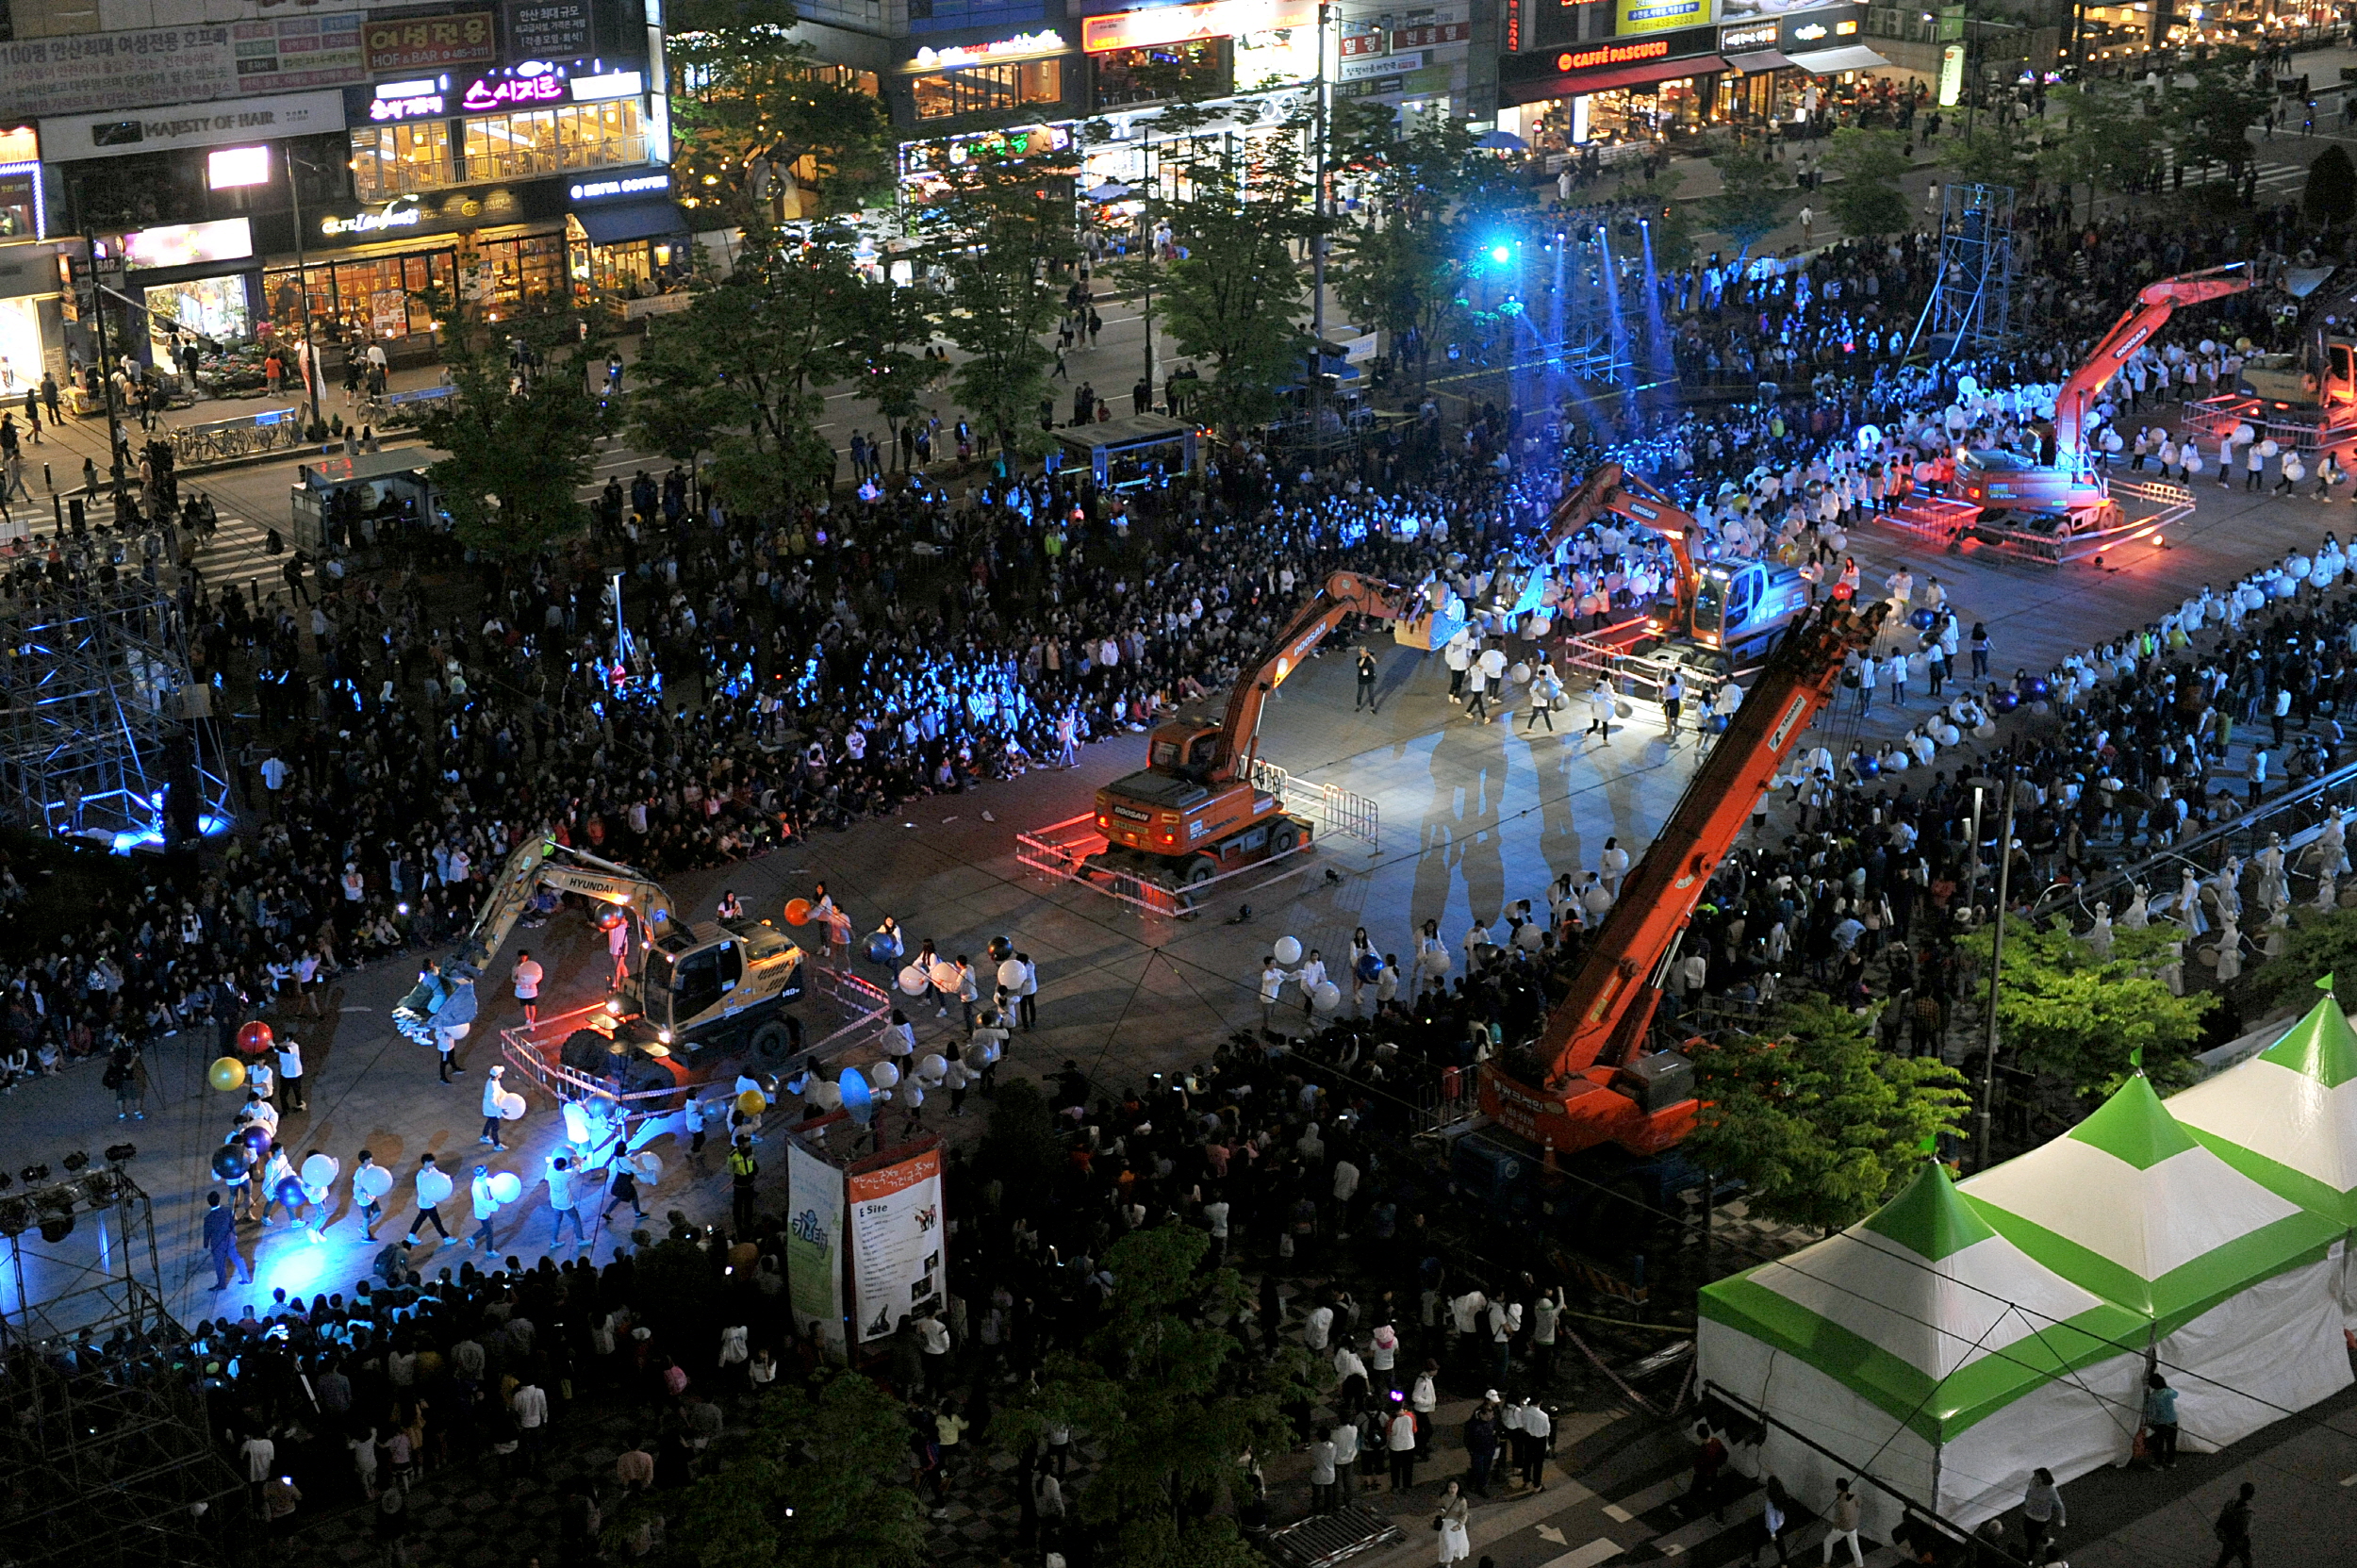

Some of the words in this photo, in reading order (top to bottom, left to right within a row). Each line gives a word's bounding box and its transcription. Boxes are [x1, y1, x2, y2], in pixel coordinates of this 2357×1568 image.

[519, 9, 538, 22] 안산
[541, 8, 558, 19] 최대
[560, 6, 579, 18] 규모
[371, 20, 486, 49] 여성전용
[1, 43, 46, 64] 100평
[51, 37, 114, 61] 안산최대
[119, 32, 179, 54] 여성전용
[1343, 36, 1376, 55] 힐링
[1573, 46, 1608, 67] CAFFÉ
[1609, 41, 1668, 62] PASCUCCI
[373, 54, 399, 67] HOF
[412, 50, 437, 63] BAR
[462, 74, 562, 109] 스시지로
[144, 118, 210, 138] MAJESTY
[215, 115, 235, 129] OF
[239, 111, 276, 127] HAIR
[97, 259, 115, 272] BAR
[339, 276, 398, 294] CAFE
[2116, 327, 2148, 358] DOOSAN
[1630, 503, 1658, 520] DOOSAN
[1294, 621, 1327, 656] DOOSAN
[1782, 698, 1802, 727] TADANO
[1114, 807, 1149, 821] DOOSAN
[569, 877, 613, 894] HYUNDAI
[853, 1169, 898, 1190] 안산국제
[866, 1205, 888, 1214] Site
